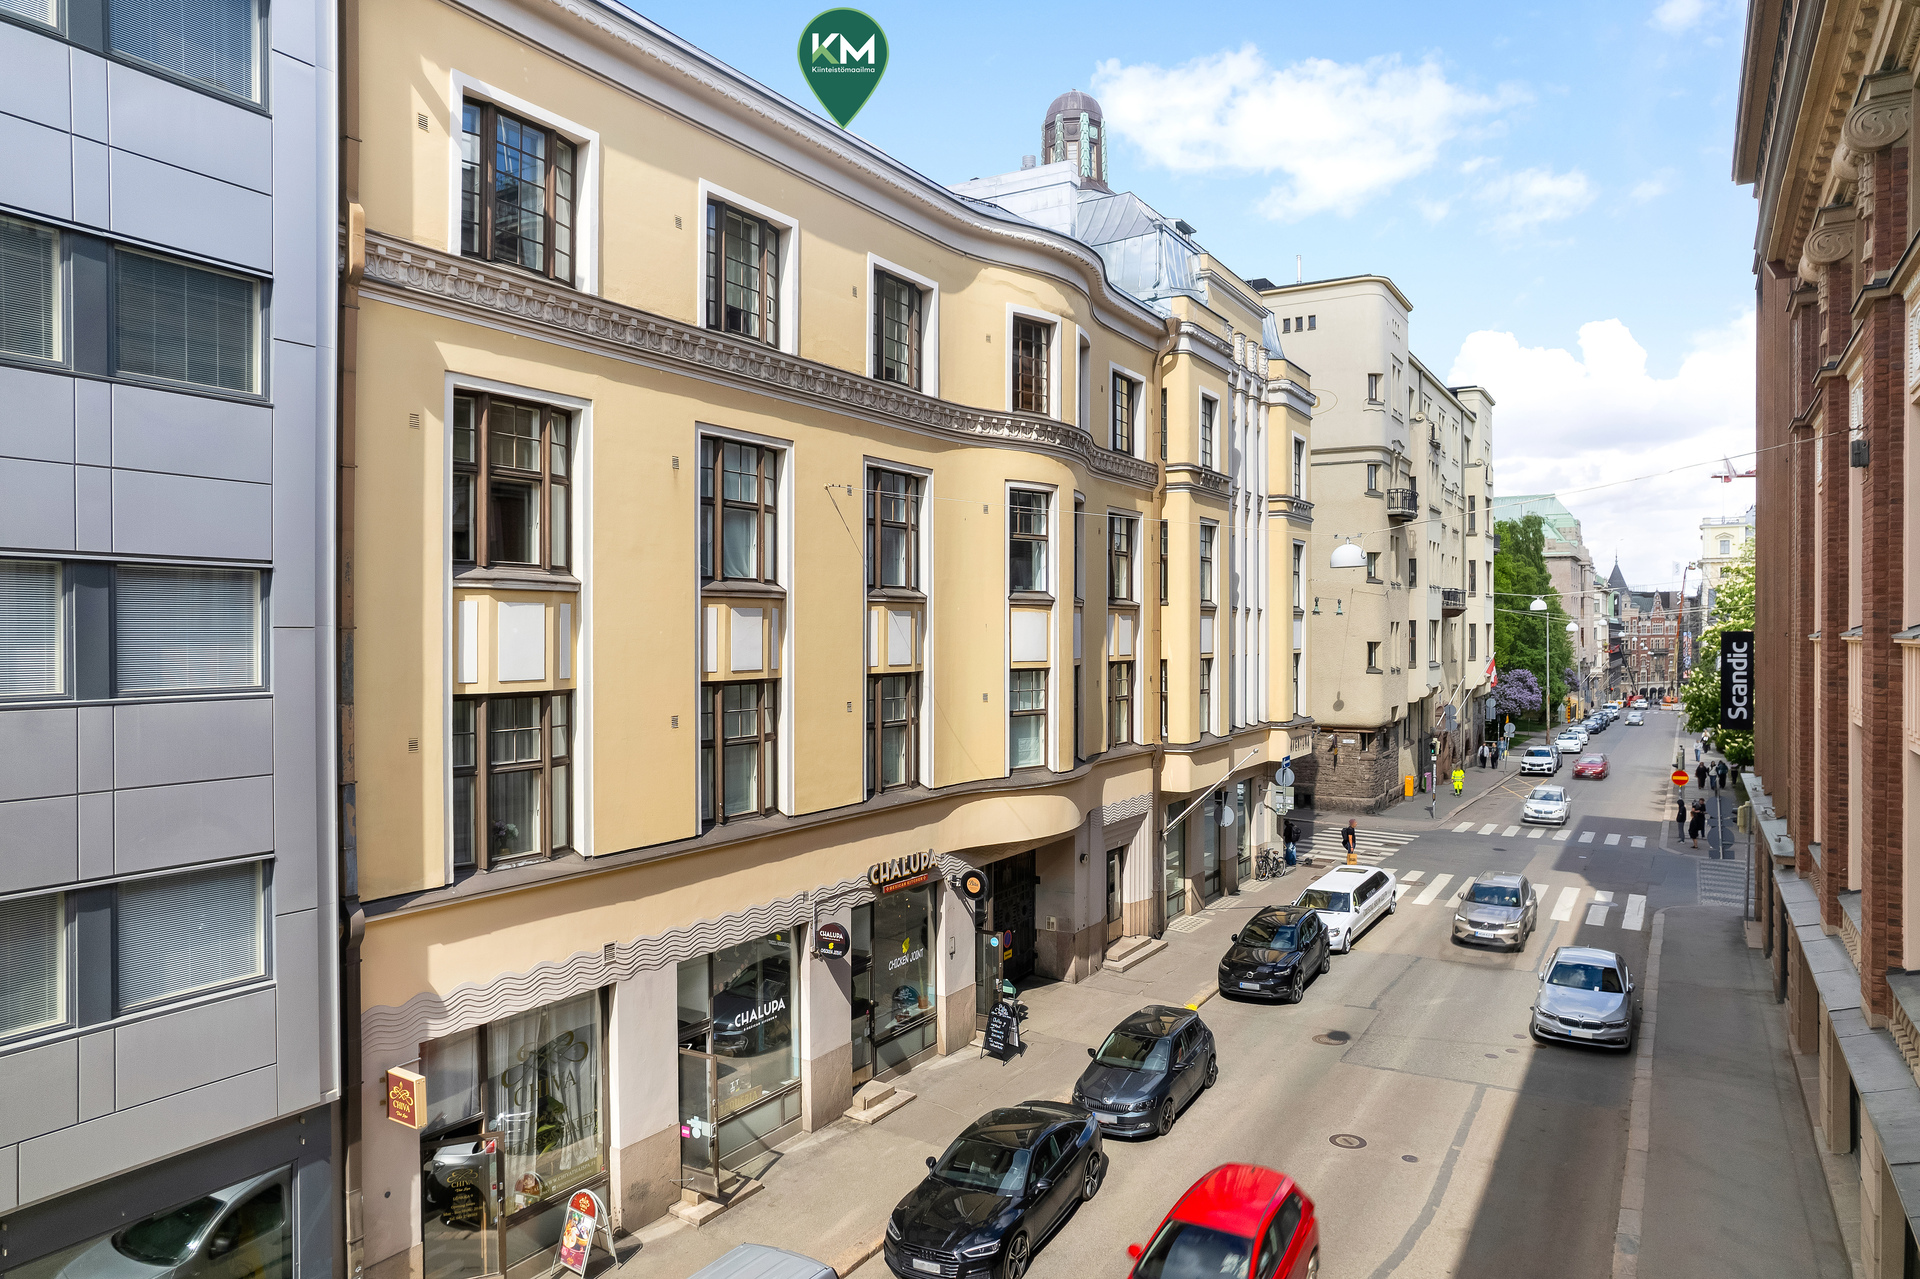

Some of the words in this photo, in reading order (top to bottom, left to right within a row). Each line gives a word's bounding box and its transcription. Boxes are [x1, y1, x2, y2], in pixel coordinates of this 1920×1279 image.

[1727, 641, 1748, 720] Scandic
[868, 848, 938, 885] CHALUPA
[889, 882, 907, 891] MEXICAN
[819, 930, 844, 939] CHALUPA
[888, 953, 909, 971] CHICKEN
[909, 947, 924, 962] JOINT
[734, 997, 786, 1028] CHALUPA
[514, 1069, 577, 1107] CHIVA
[393, 1100, 410, 1112] CHIVA
[451, 1180, 474, 1188] CHIVA
